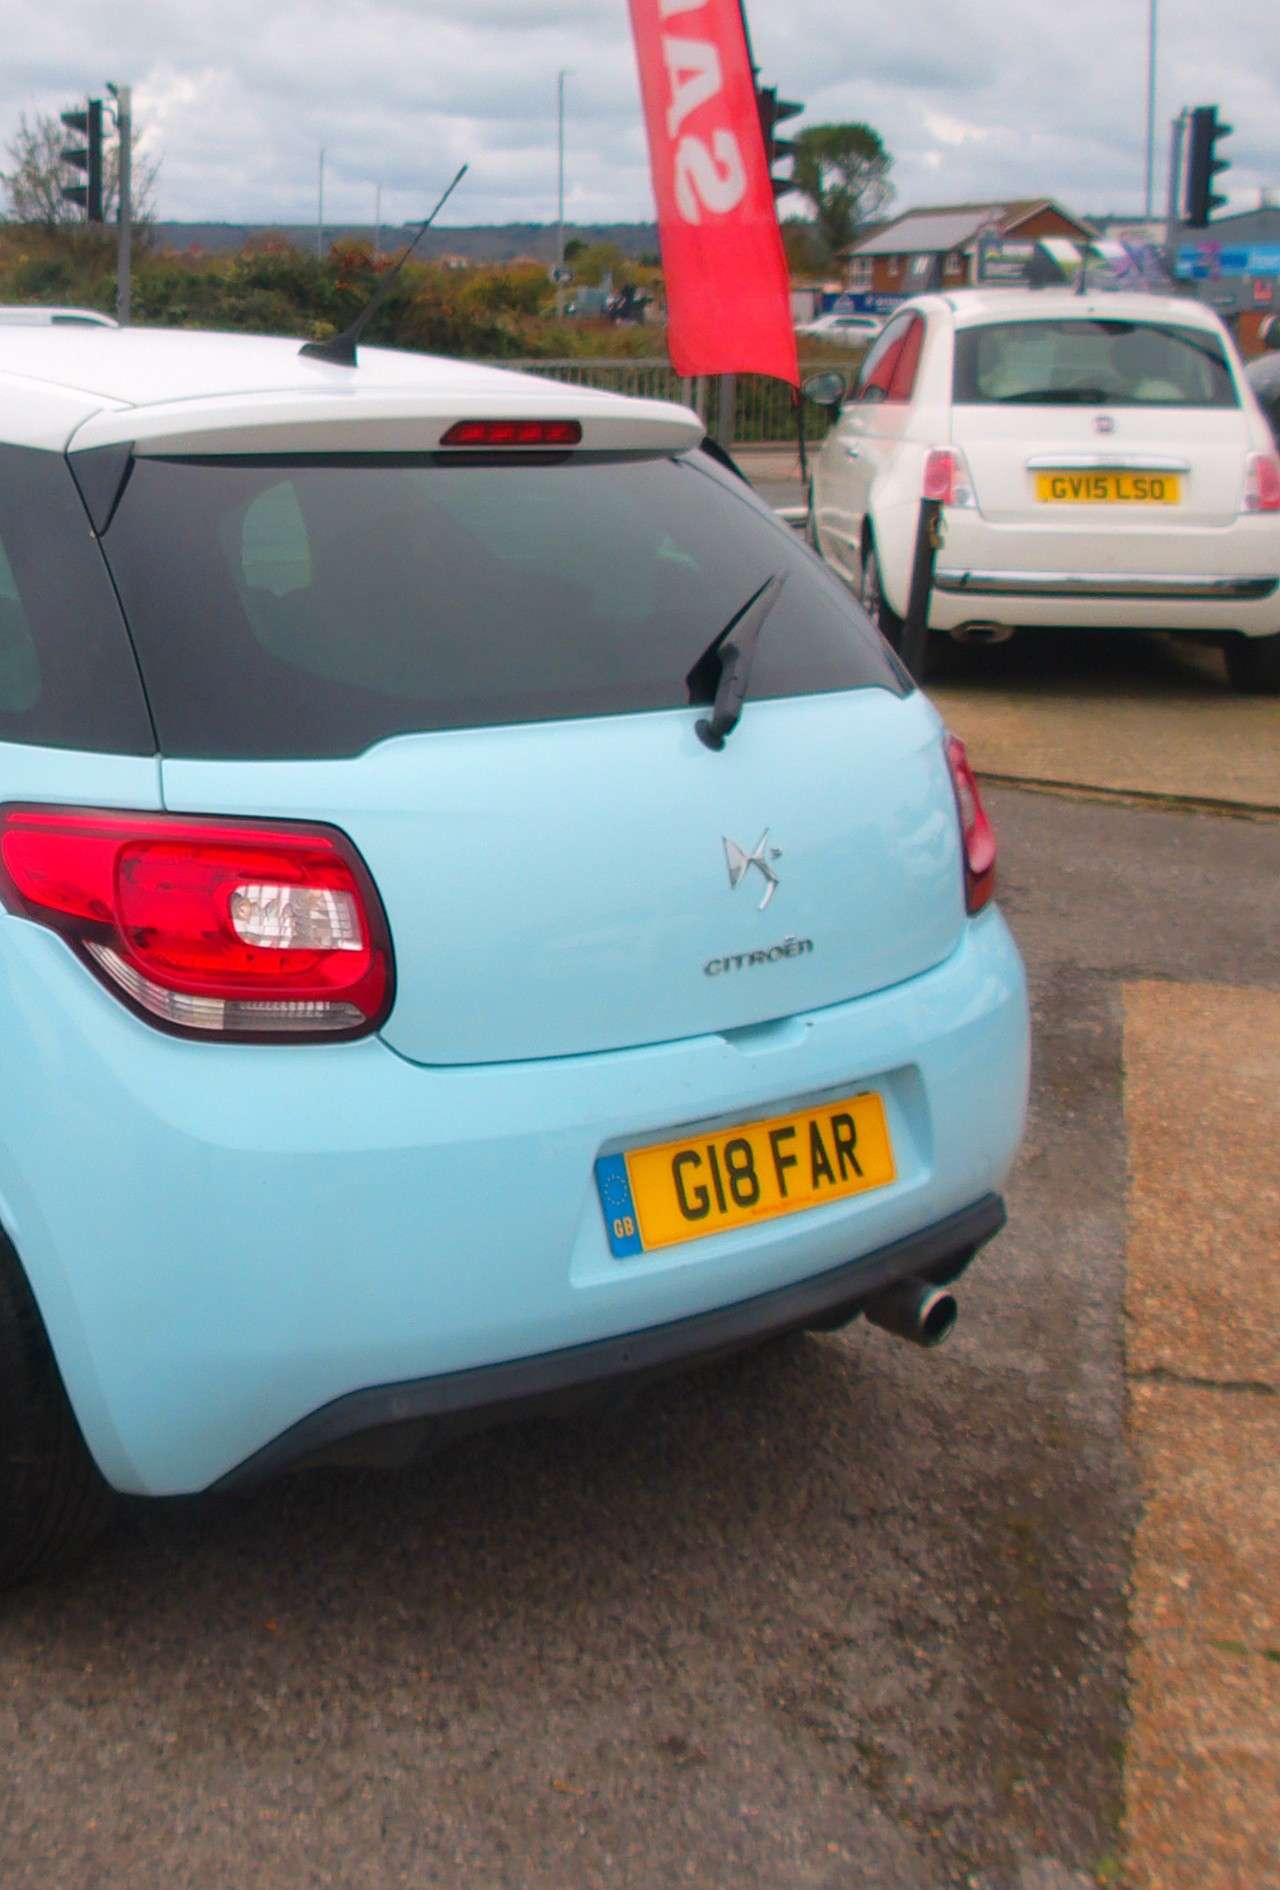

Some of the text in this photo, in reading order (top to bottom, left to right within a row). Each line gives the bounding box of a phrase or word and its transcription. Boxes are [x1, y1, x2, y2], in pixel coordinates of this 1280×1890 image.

[1051, 477, 1166, 501] GV15 LSO
[671, 1113, 864, 1222] G18 FAR
[613, 1216, 635, 1239] GB
